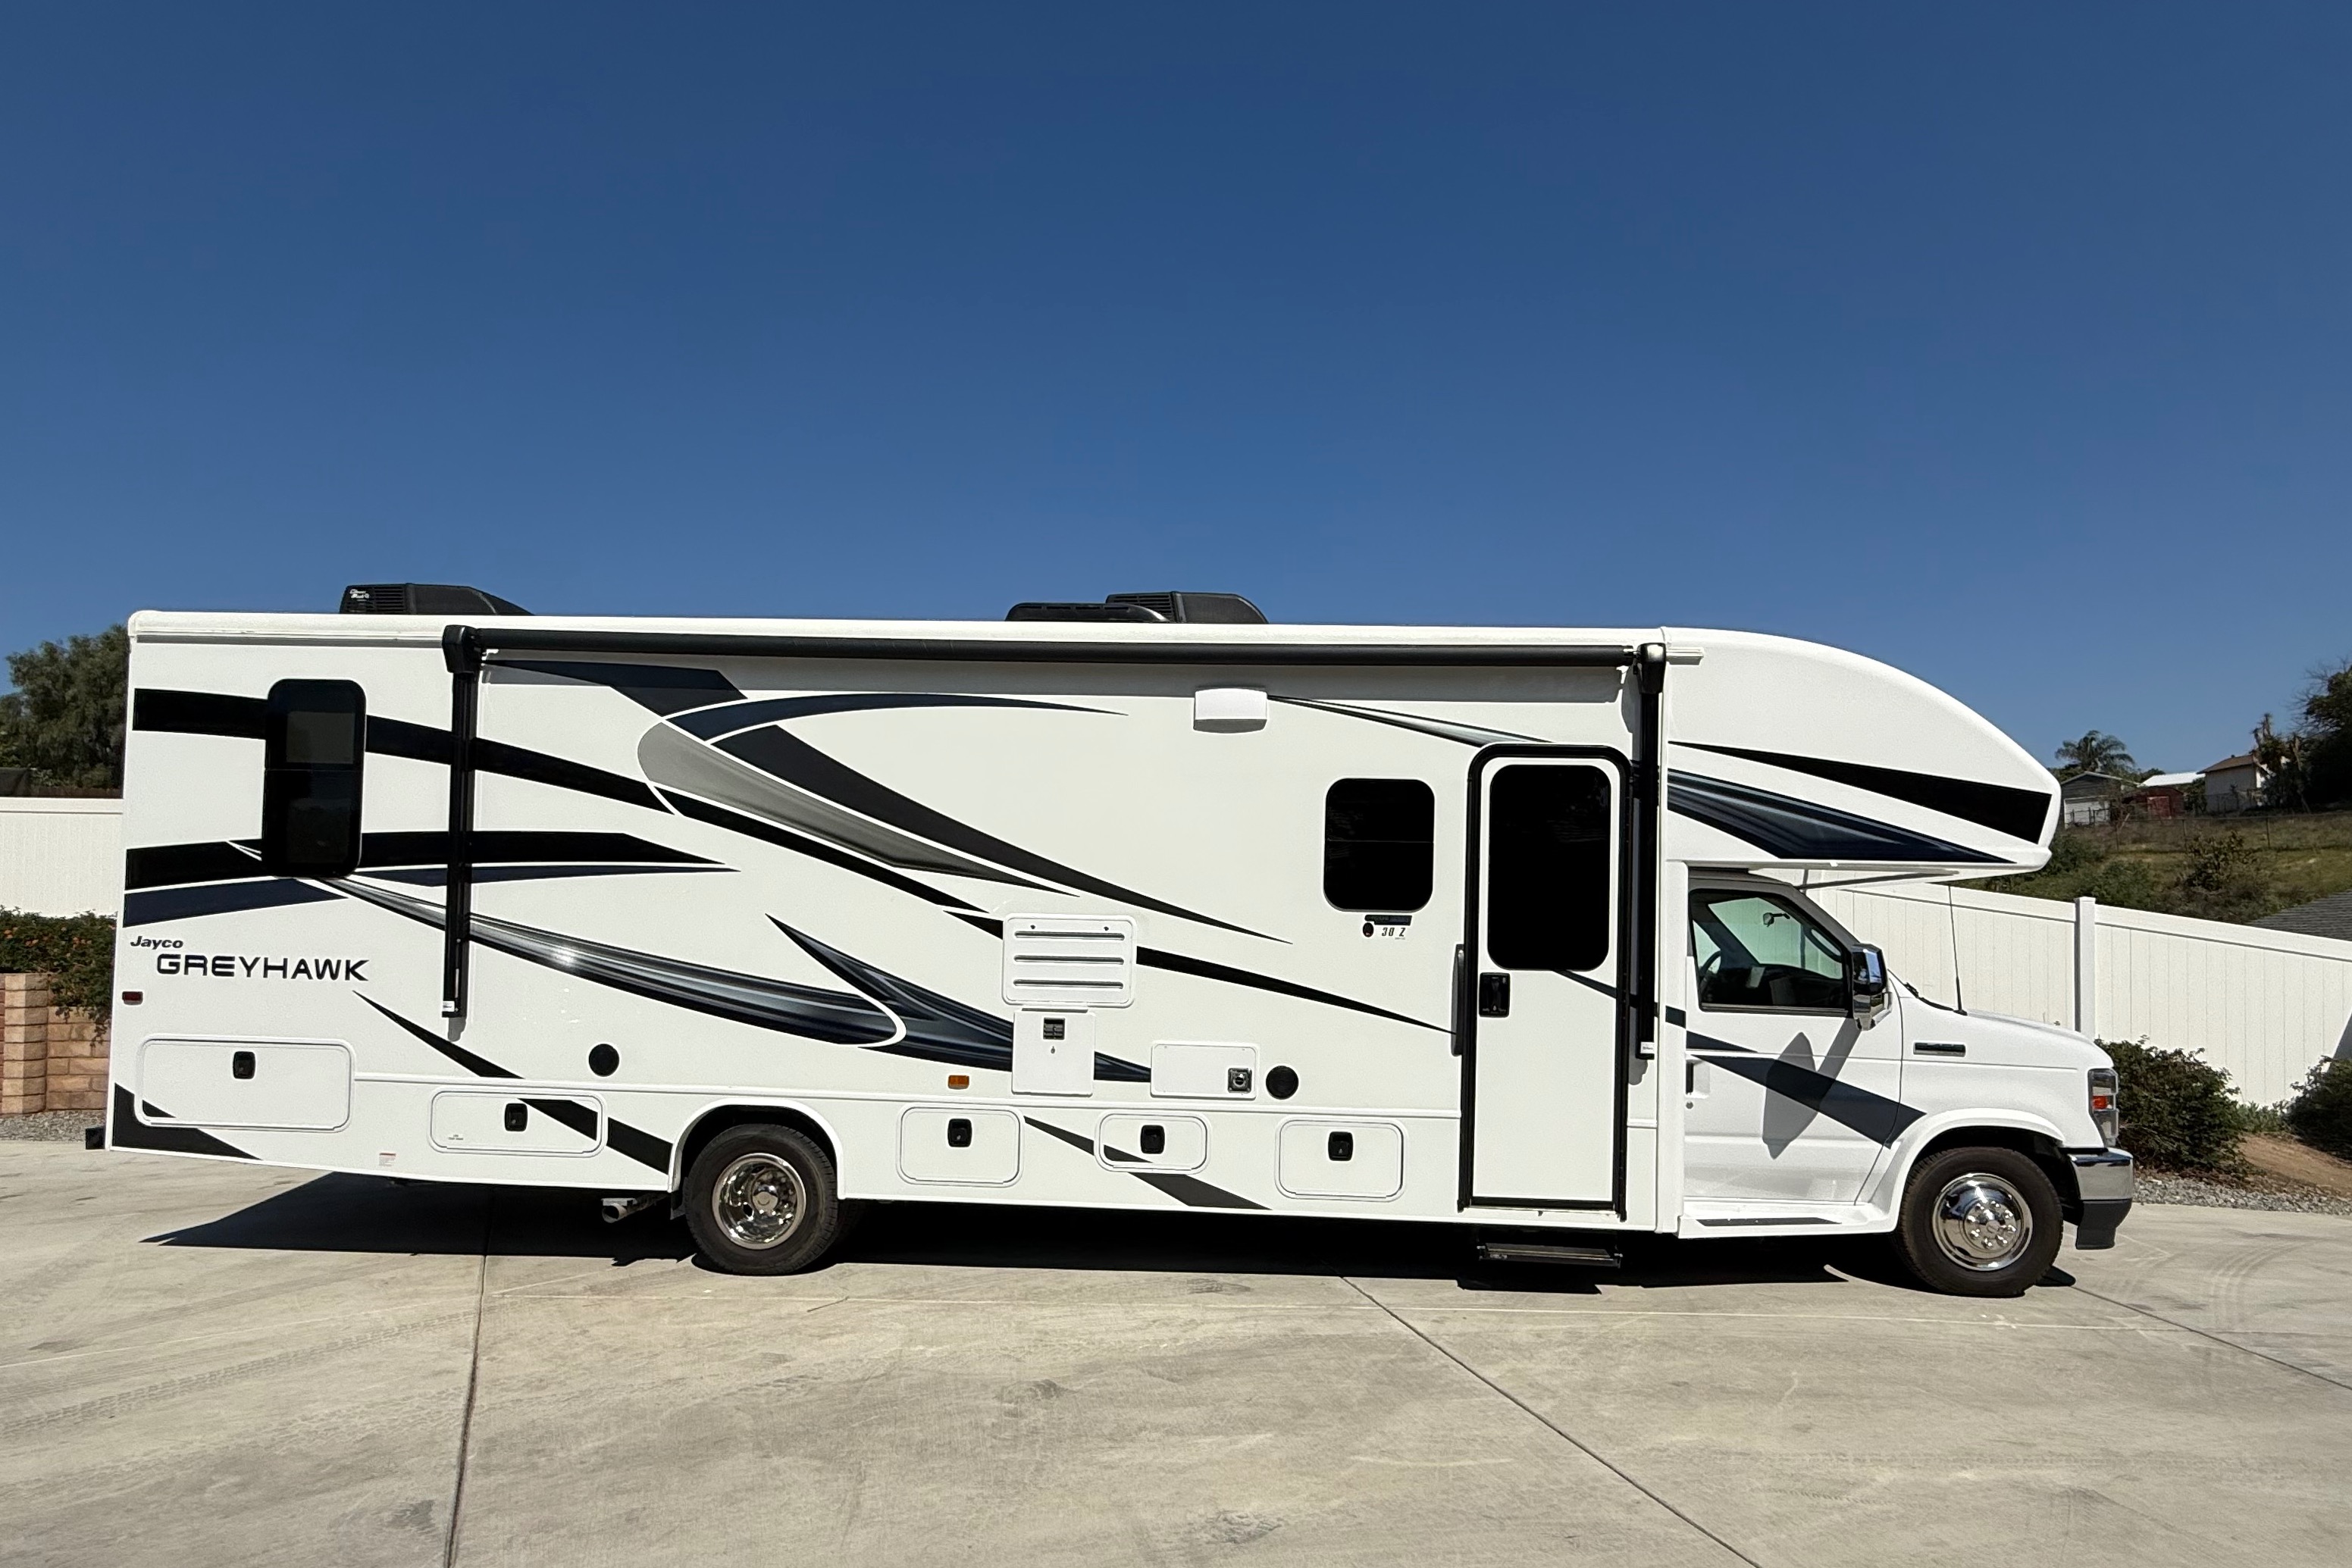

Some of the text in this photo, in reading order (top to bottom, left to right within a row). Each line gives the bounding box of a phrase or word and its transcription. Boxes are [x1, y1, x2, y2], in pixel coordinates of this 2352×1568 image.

[1381, 927, 1406, 937] 30 Z
[130, 936, 183, 950] Jayco
[157, 953, 369, 981] GREYHAWK
